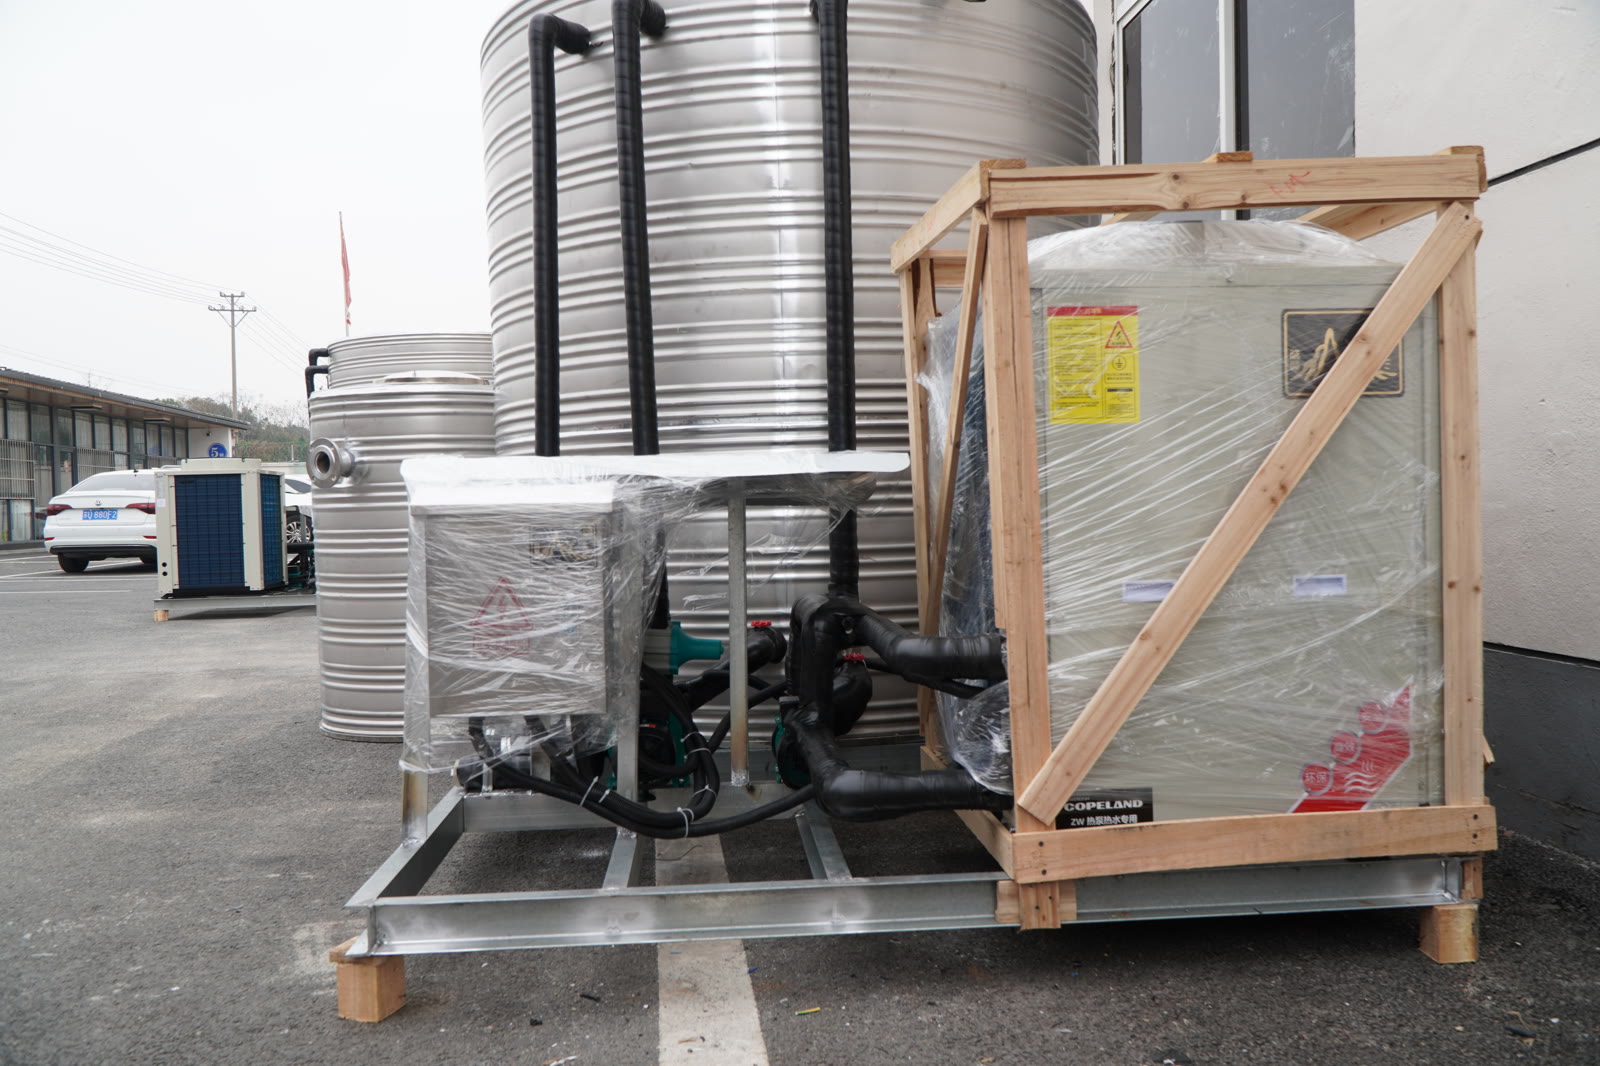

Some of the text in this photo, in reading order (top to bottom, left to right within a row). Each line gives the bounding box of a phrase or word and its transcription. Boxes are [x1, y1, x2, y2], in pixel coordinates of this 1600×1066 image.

[1305, 772, 1327, 783] 环保
[1063, 799, 1143, 812] COPELAND
[1070, 818, 1085, 826] ZW
